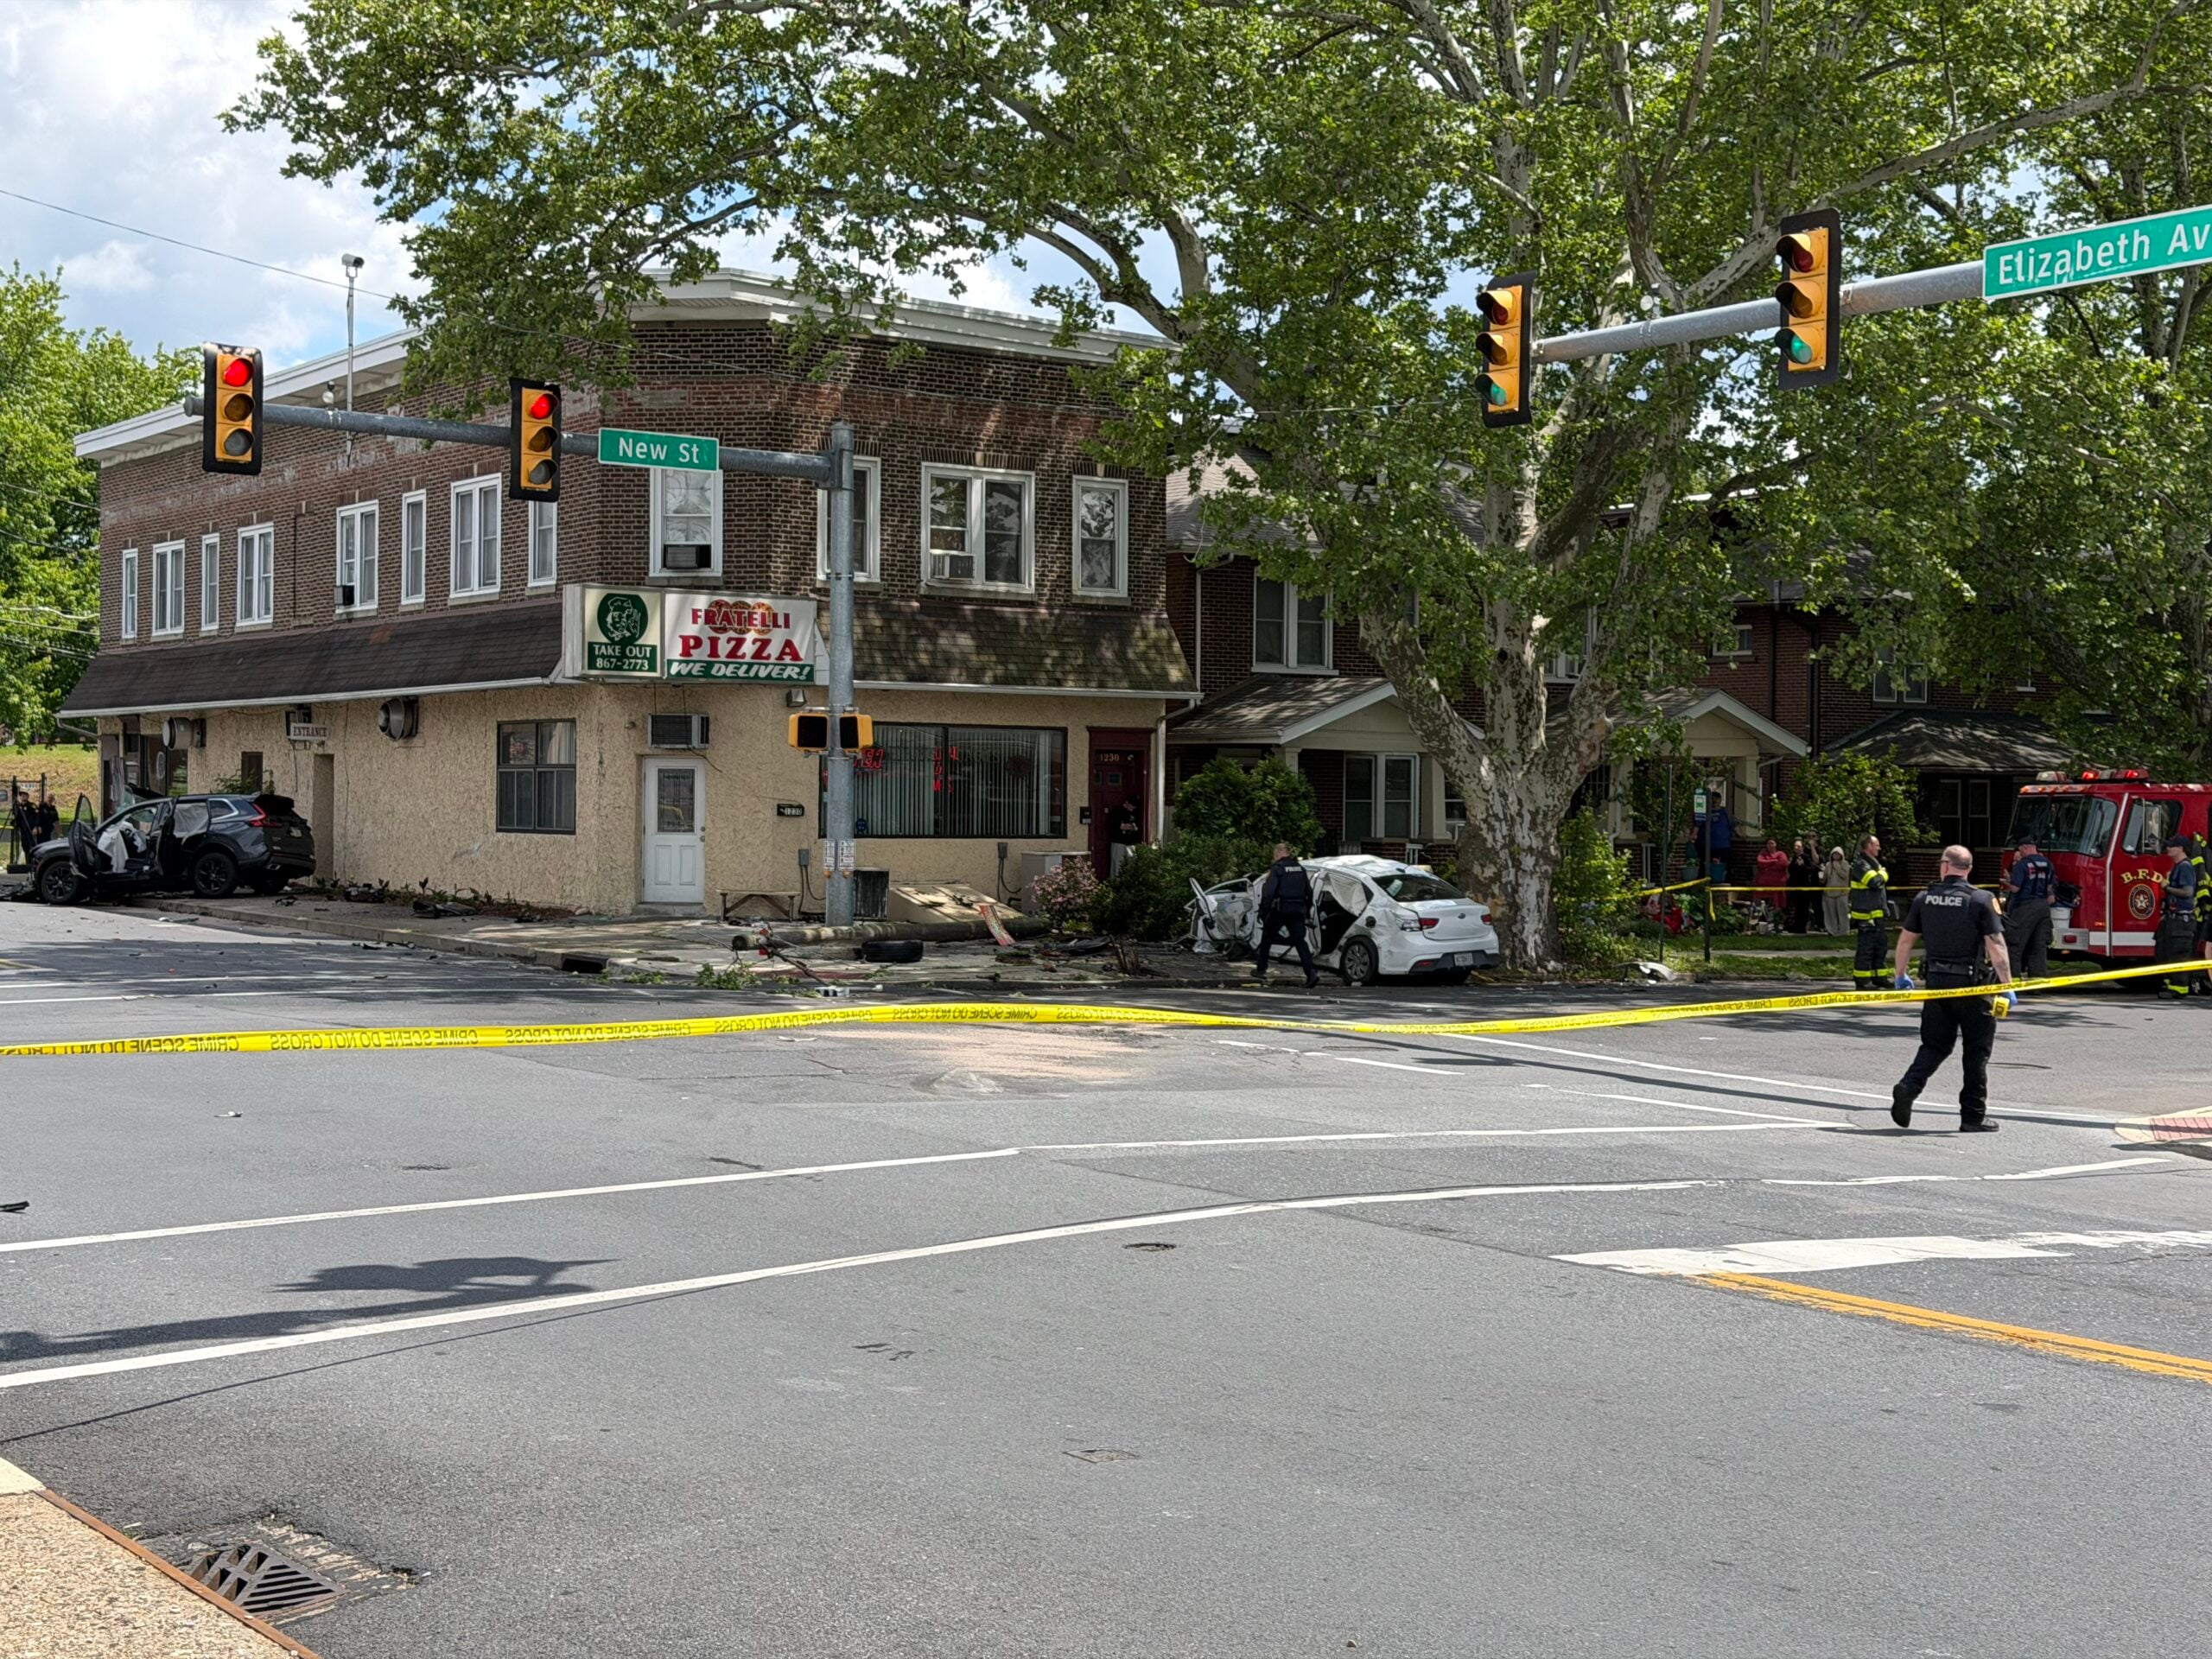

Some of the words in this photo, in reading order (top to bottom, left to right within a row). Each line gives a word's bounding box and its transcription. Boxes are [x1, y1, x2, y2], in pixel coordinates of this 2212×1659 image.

[1999, 229, 2151, 285] Elizabeth
[2166, 223, 2212, 257] Av
[618, 436, 668, 461] New
[678, 442, 700, 464] St
[691, 607, 791, 629] FRATELLI
[594, 645, 621, 657] TAKE
[626, 645, 652, 658] OUT
[678, 634, 804, 663] PIZZA
[595, 658, 650, 671] 867-2773
[671, 662, 706, 677] WE
[710, 663, 810, 681] DELIVER!
[293, 726, 327, 737] ENTRANCE
[1100, 753, 1120, 761] 1230
[1925, 895, 1963, 906] POLICE
